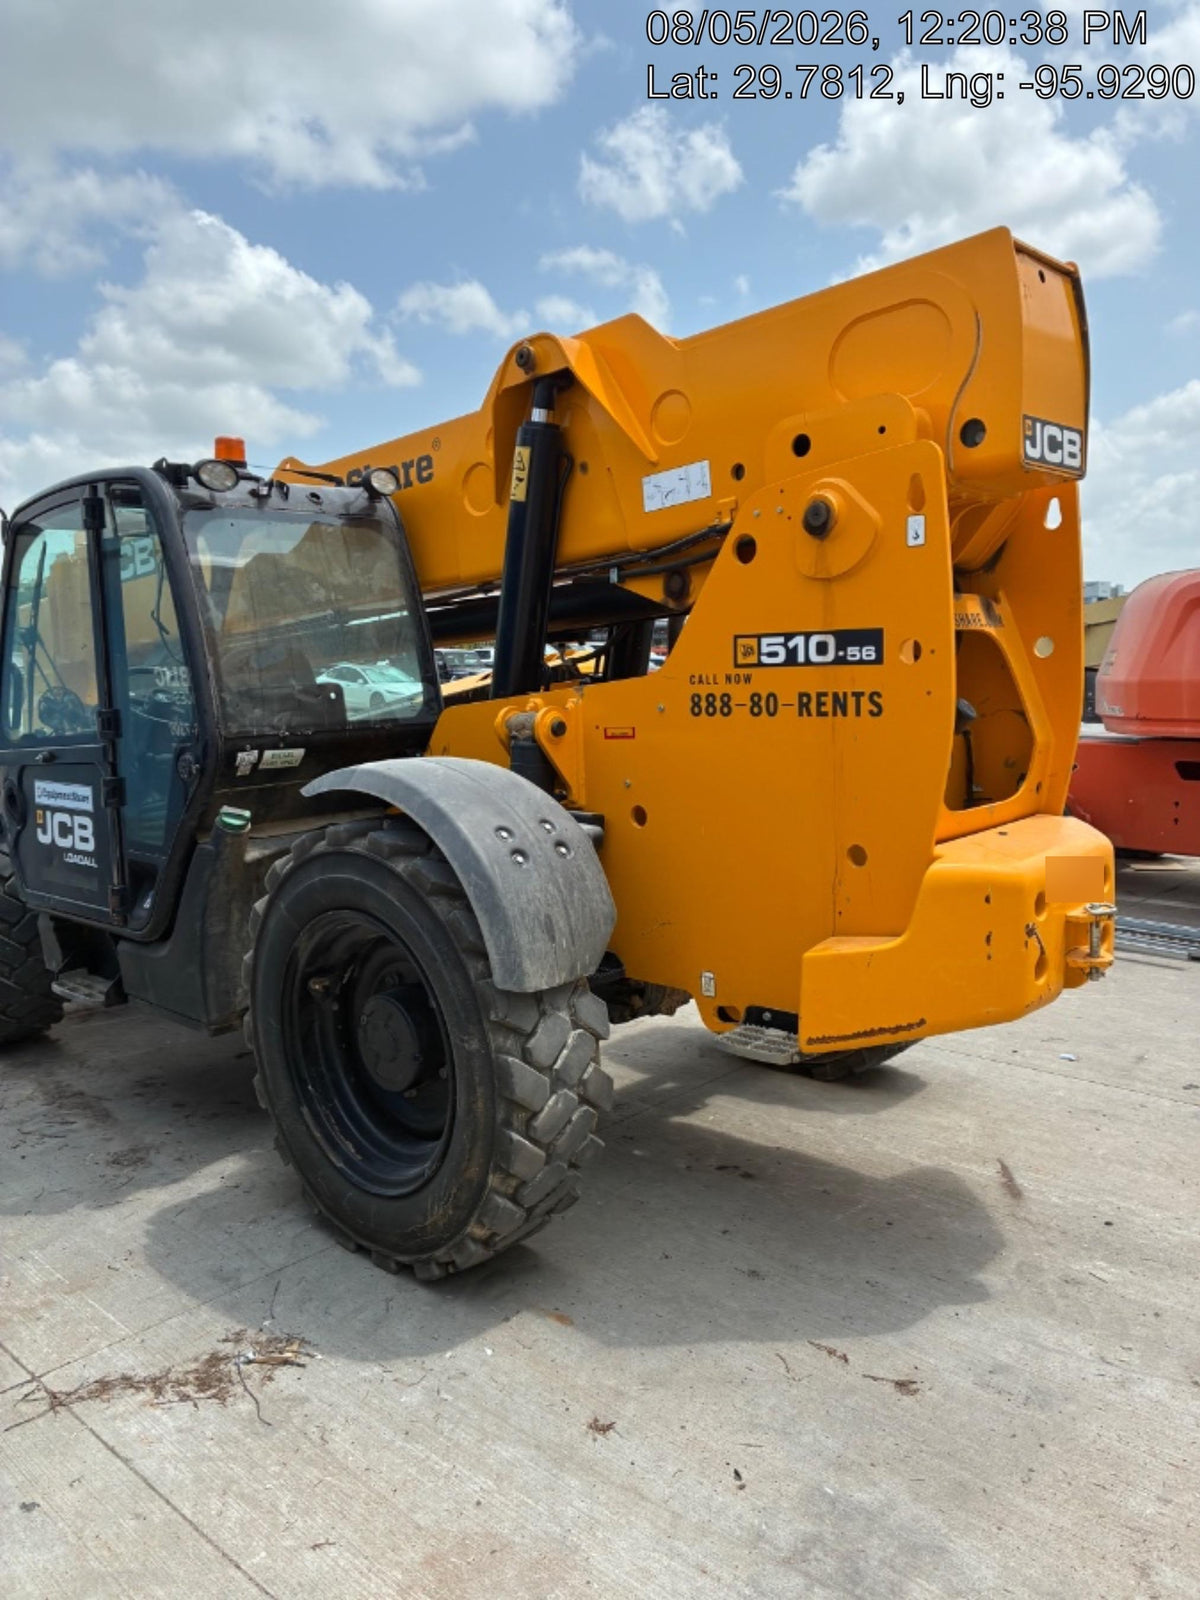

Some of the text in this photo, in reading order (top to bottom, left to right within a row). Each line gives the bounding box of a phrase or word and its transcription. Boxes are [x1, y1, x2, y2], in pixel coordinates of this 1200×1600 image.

[1025, 422, 1082, 468] JCB
[689, 673, 753, 685] CALL NOW
[690, 691, 884, 718] 888-80-RENTS
[36, 810, 95, 852] JCB
